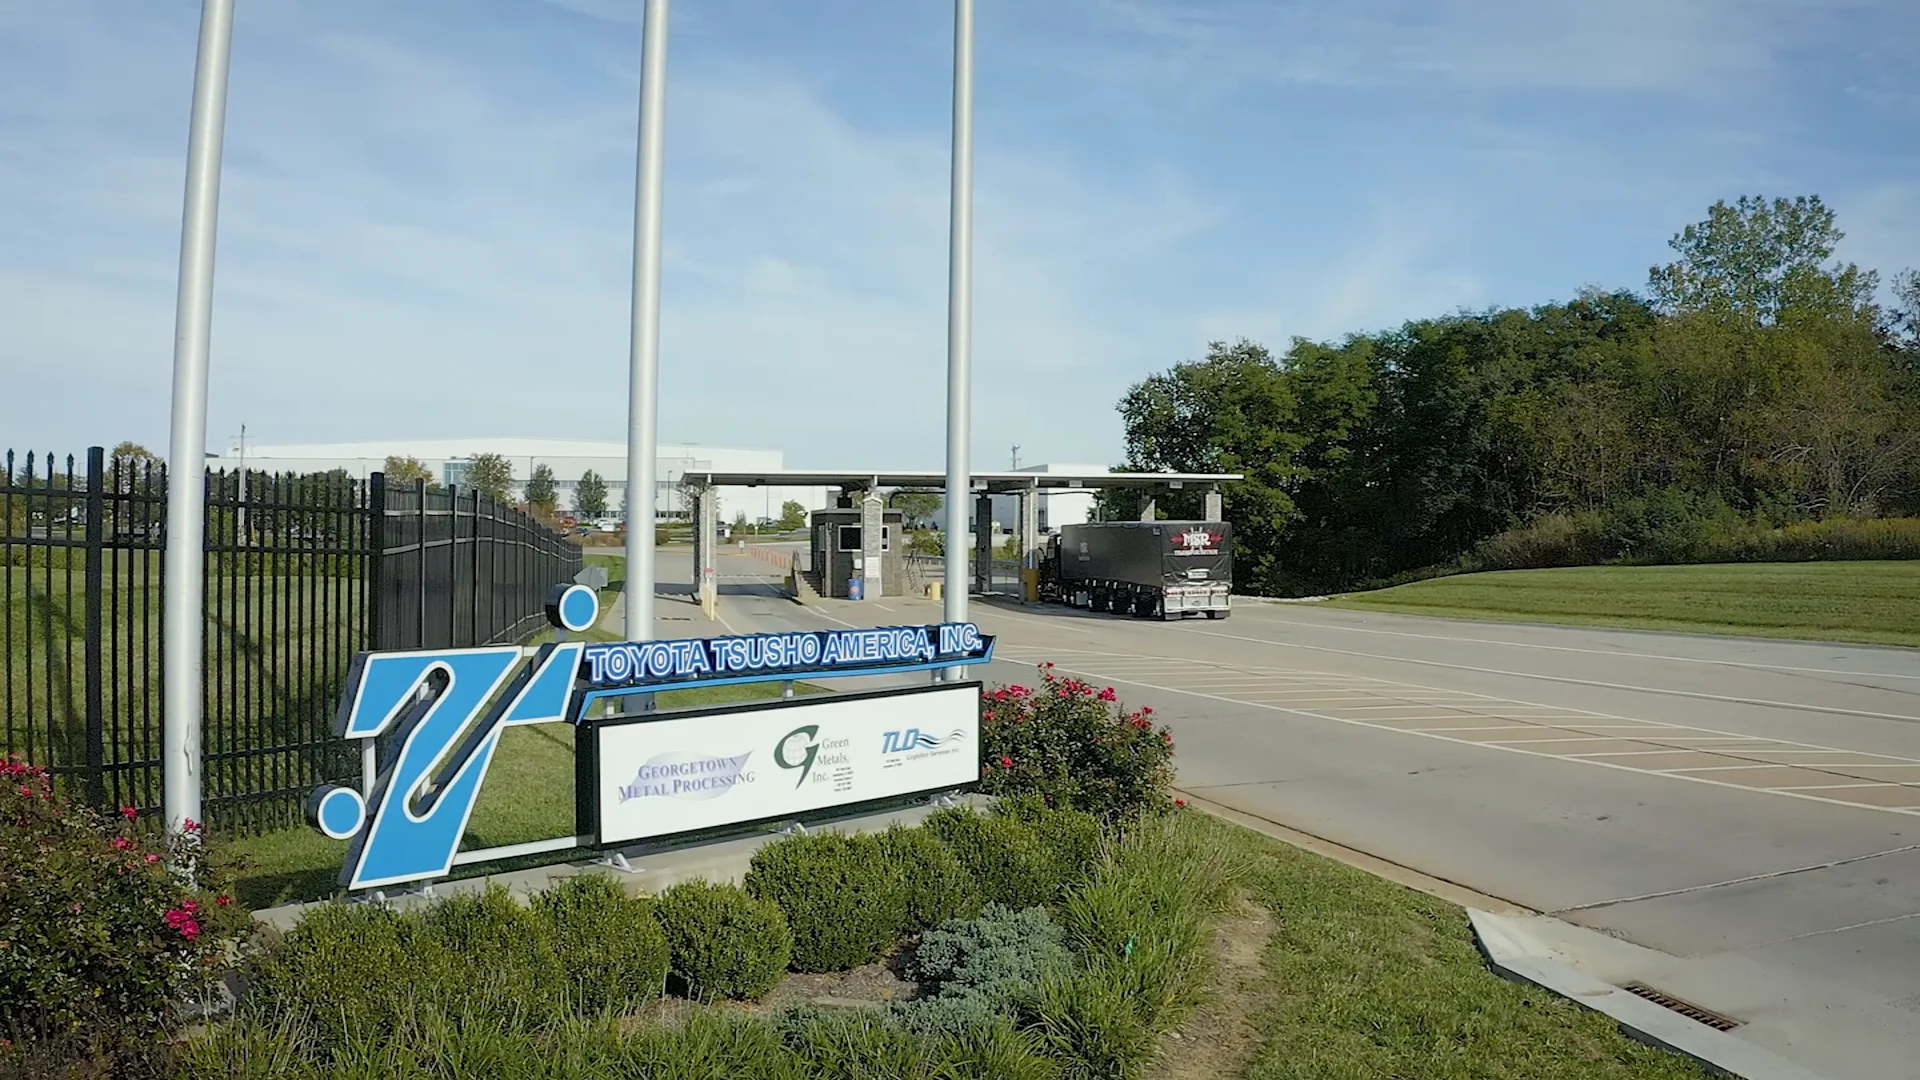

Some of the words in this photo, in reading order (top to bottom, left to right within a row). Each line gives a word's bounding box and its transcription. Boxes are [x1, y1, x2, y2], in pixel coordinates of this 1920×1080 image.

[586, 640, 710, 684] TOYOTA
[710, 633, 820, 671] TSUSHO
[823, 628, 935, 660] AMERICA,
[939, 623, 982, 653] INC.
[821, 738, 849, 750] Green
[882, 728, 919, 754] TLD
[638, 757, 739, 780] GEORGETOWN
[812, 771, 830, 783] Inc.
[618, 782, 670, 801] METAL
[673, 771, 756, 795] PROCESSING
